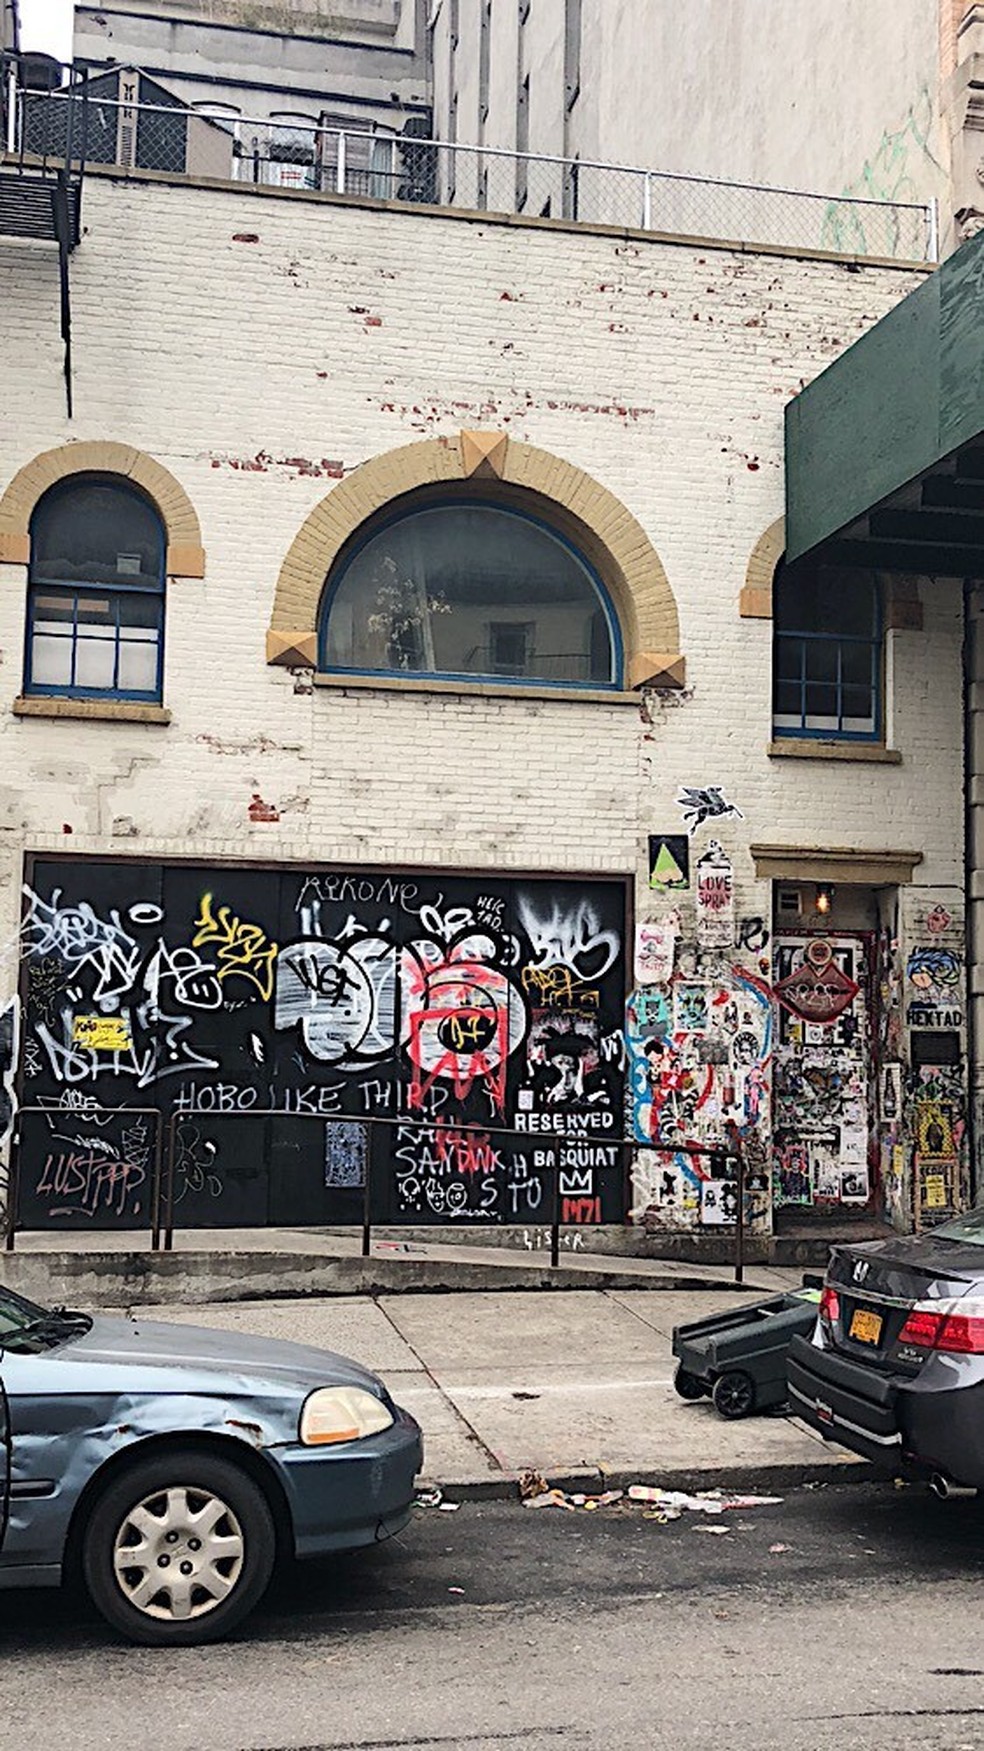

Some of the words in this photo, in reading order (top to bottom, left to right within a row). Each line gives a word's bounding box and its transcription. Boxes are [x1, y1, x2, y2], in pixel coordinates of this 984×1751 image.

[698, 874, 731, 891] LOVE
[173, 1082, 258, 1112] HOBO
[514, 1112, 614, 1132] RESERVED
[533, 1146, 619, 1169] BASQUIAT
